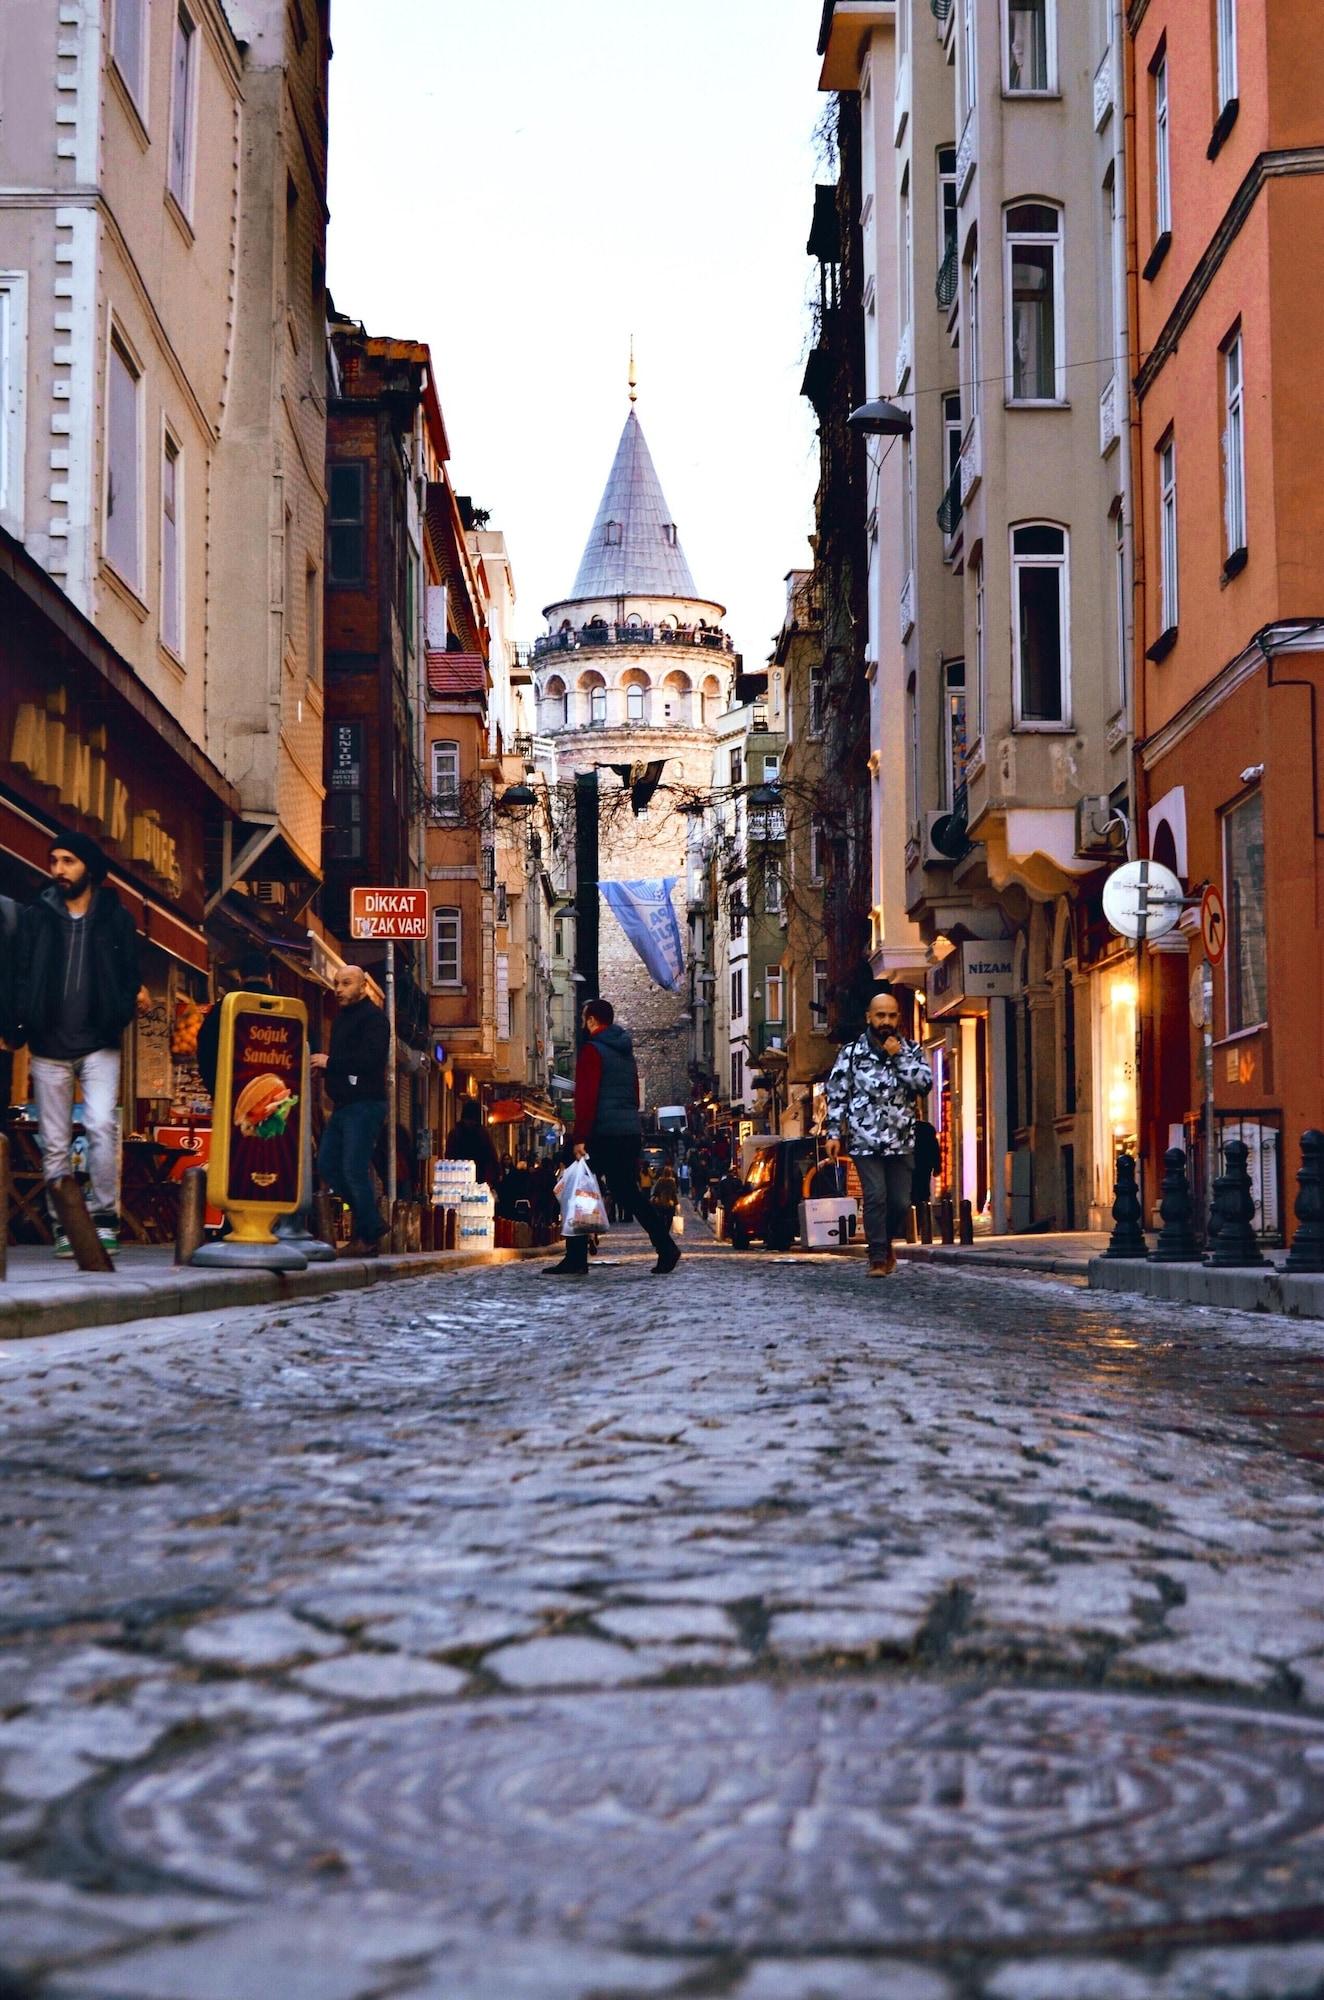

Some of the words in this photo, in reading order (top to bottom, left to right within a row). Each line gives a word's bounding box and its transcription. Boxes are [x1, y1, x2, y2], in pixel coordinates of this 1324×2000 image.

[365, 892, 416, 913] DİKKAT
[354, 917, 396, 934] TZAK
[397, 917, 425, 935] VAR!
[968, 961, 1012, 974] NİZAM
[250, 1025, 288, 1045] Soğuk
[243, 1047, 293, 1070] Sandviç
